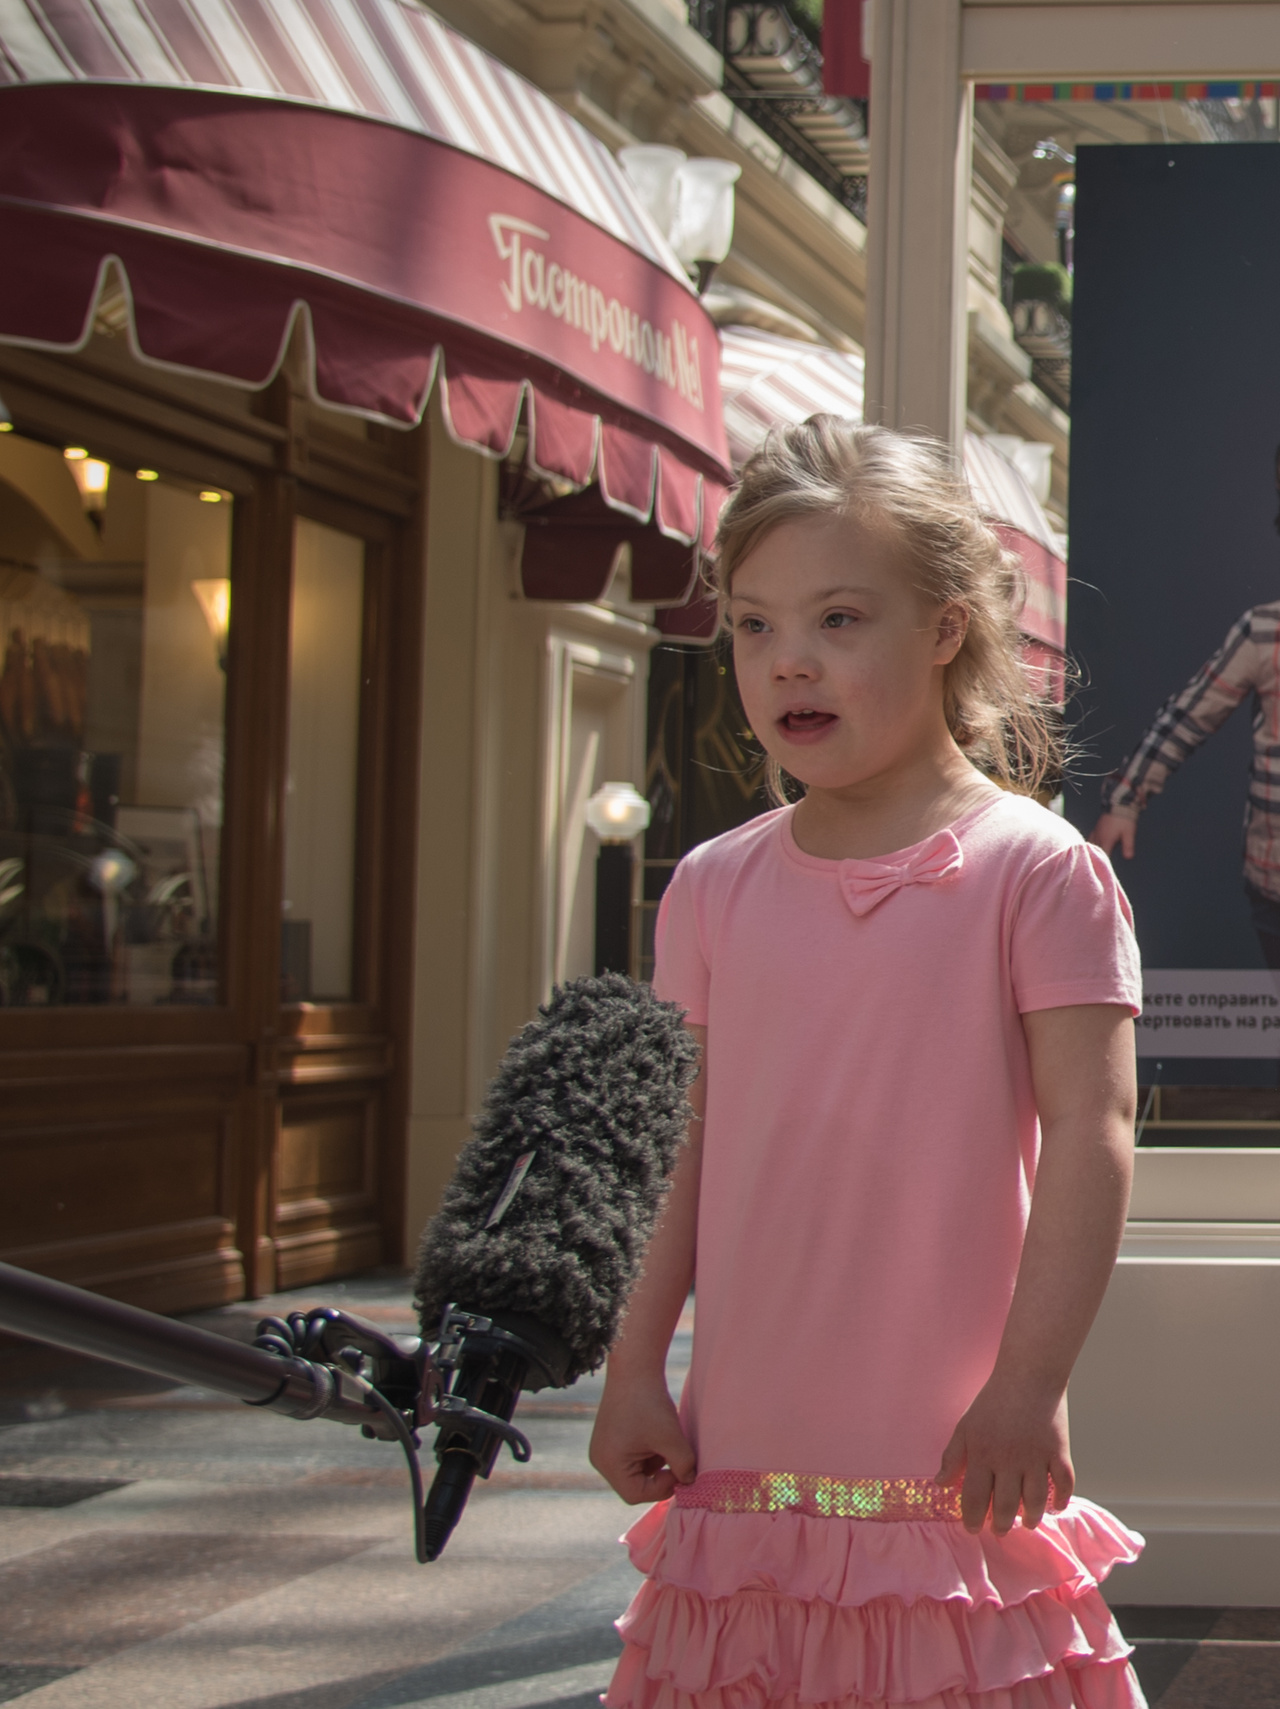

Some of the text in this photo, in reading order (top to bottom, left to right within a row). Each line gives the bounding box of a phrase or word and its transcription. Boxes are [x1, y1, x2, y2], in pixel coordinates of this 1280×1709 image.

[489, 212, 678, 390] Гастроном
[1187, 993, 1279, 1010] отправить
[1134, 1014, 1233, 1032] ертвовать
[1235, 1015, 1258, 1029] на
